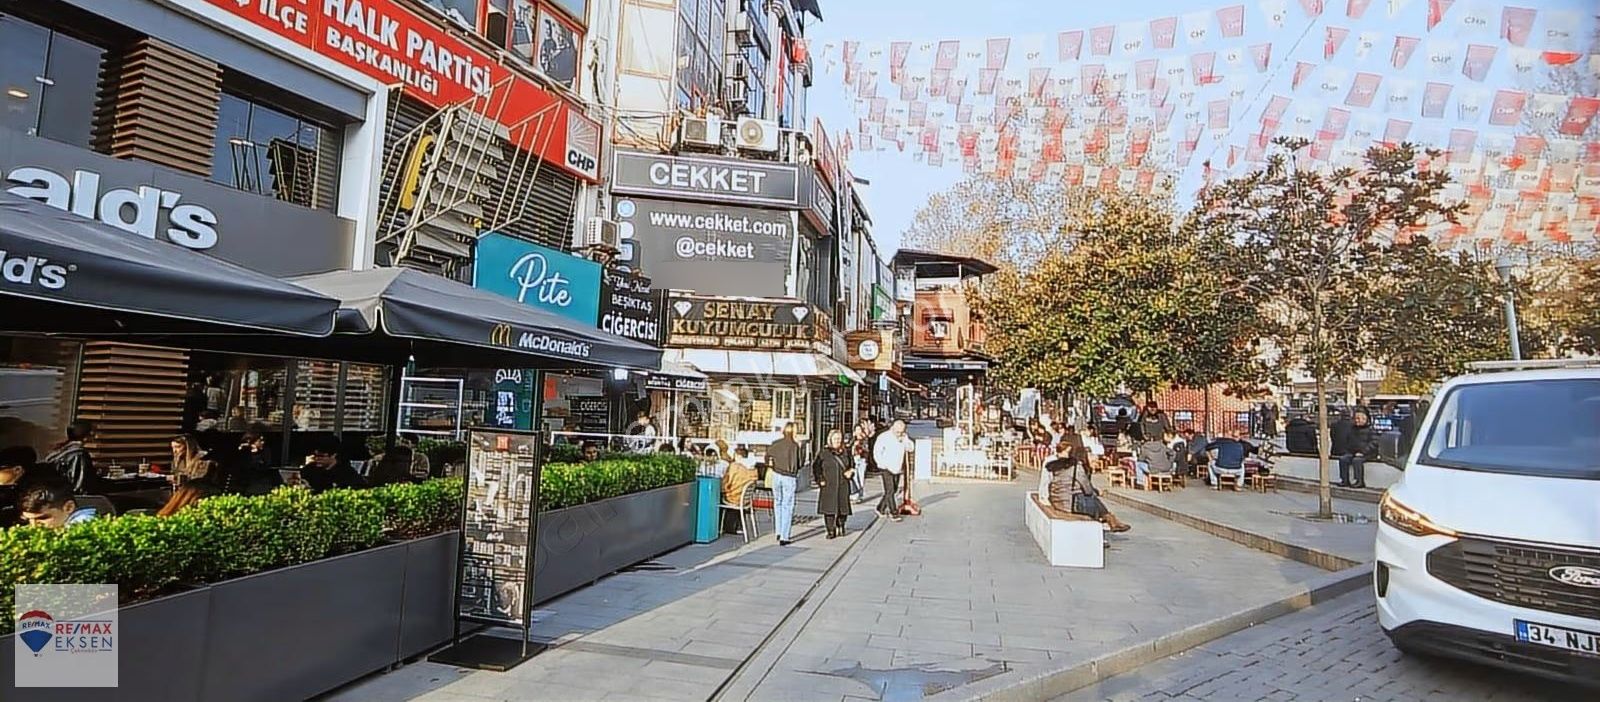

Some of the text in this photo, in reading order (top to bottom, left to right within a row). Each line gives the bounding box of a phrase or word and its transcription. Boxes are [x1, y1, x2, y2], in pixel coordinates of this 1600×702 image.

[323, 0, 492, 98] HALK PARTİSİ
[325, 26, 438, 96] BAŞKANLIĞI
[568, 151, 595, 171] CHP
[649, 162, 767, 194] CEKKET
[0, 166, 218, 249] ald's
[650, 211, 787, 238] www.cekket.com
[676, 236, 755, 259] @cekket
[509, 253, 572, 307] Pite
[671, 318, 810, 339] KUYUMCULUK
[518, 332, 590, 357] McDonald's
[1529, 625, 1600, 653] 34 NJ
